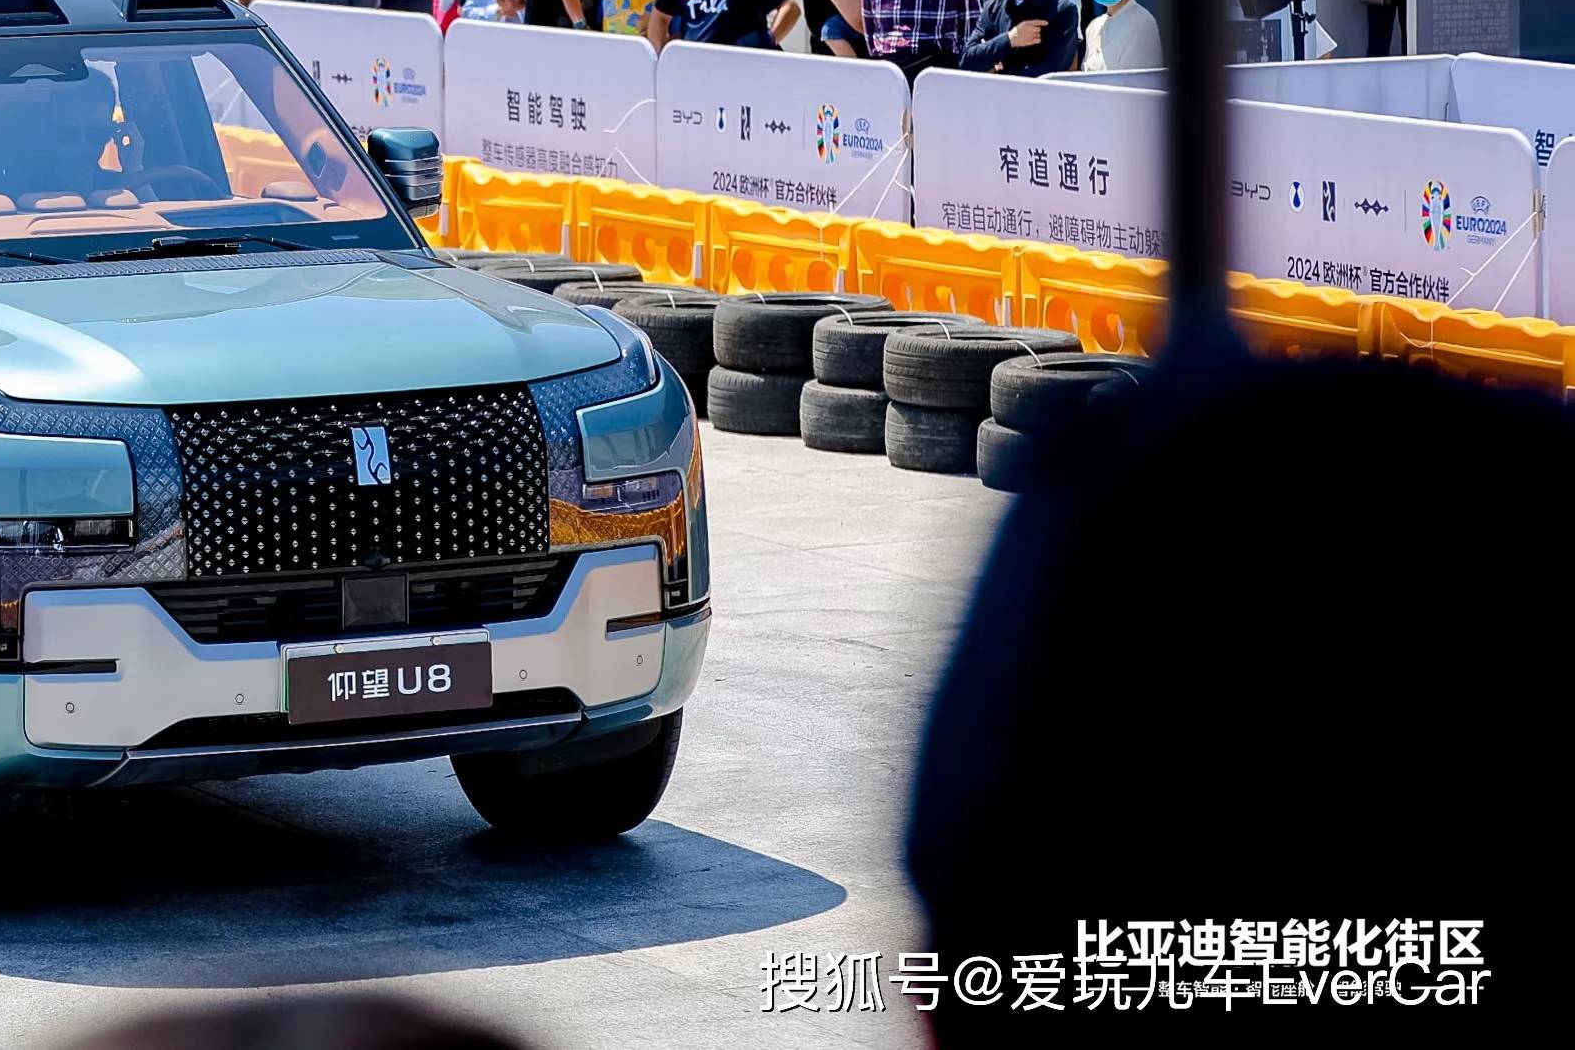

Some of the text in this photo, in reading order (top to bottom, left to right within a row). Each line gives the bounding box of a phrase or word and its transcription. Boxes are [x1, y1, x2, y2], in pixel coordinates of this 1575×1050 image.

[506, 88, 587, 131] 智能驾驶
[673, 109, 703, 125] BYD
[842, 133, 883, 152] EURO2024
[712, 171, 738, 193] 2024
[999, 144, 1110, 196] 窄道通行
[1231, 180, 1271, 201] BYD
[941, 200, 1171, 257] 窄道自动通行，避障碍物主动躲
[1455, 215, 1507, 236] EURO2024
[1287, 256, 1321, 282] 2024
[327, 663, 452, 702] 仰望 U8
